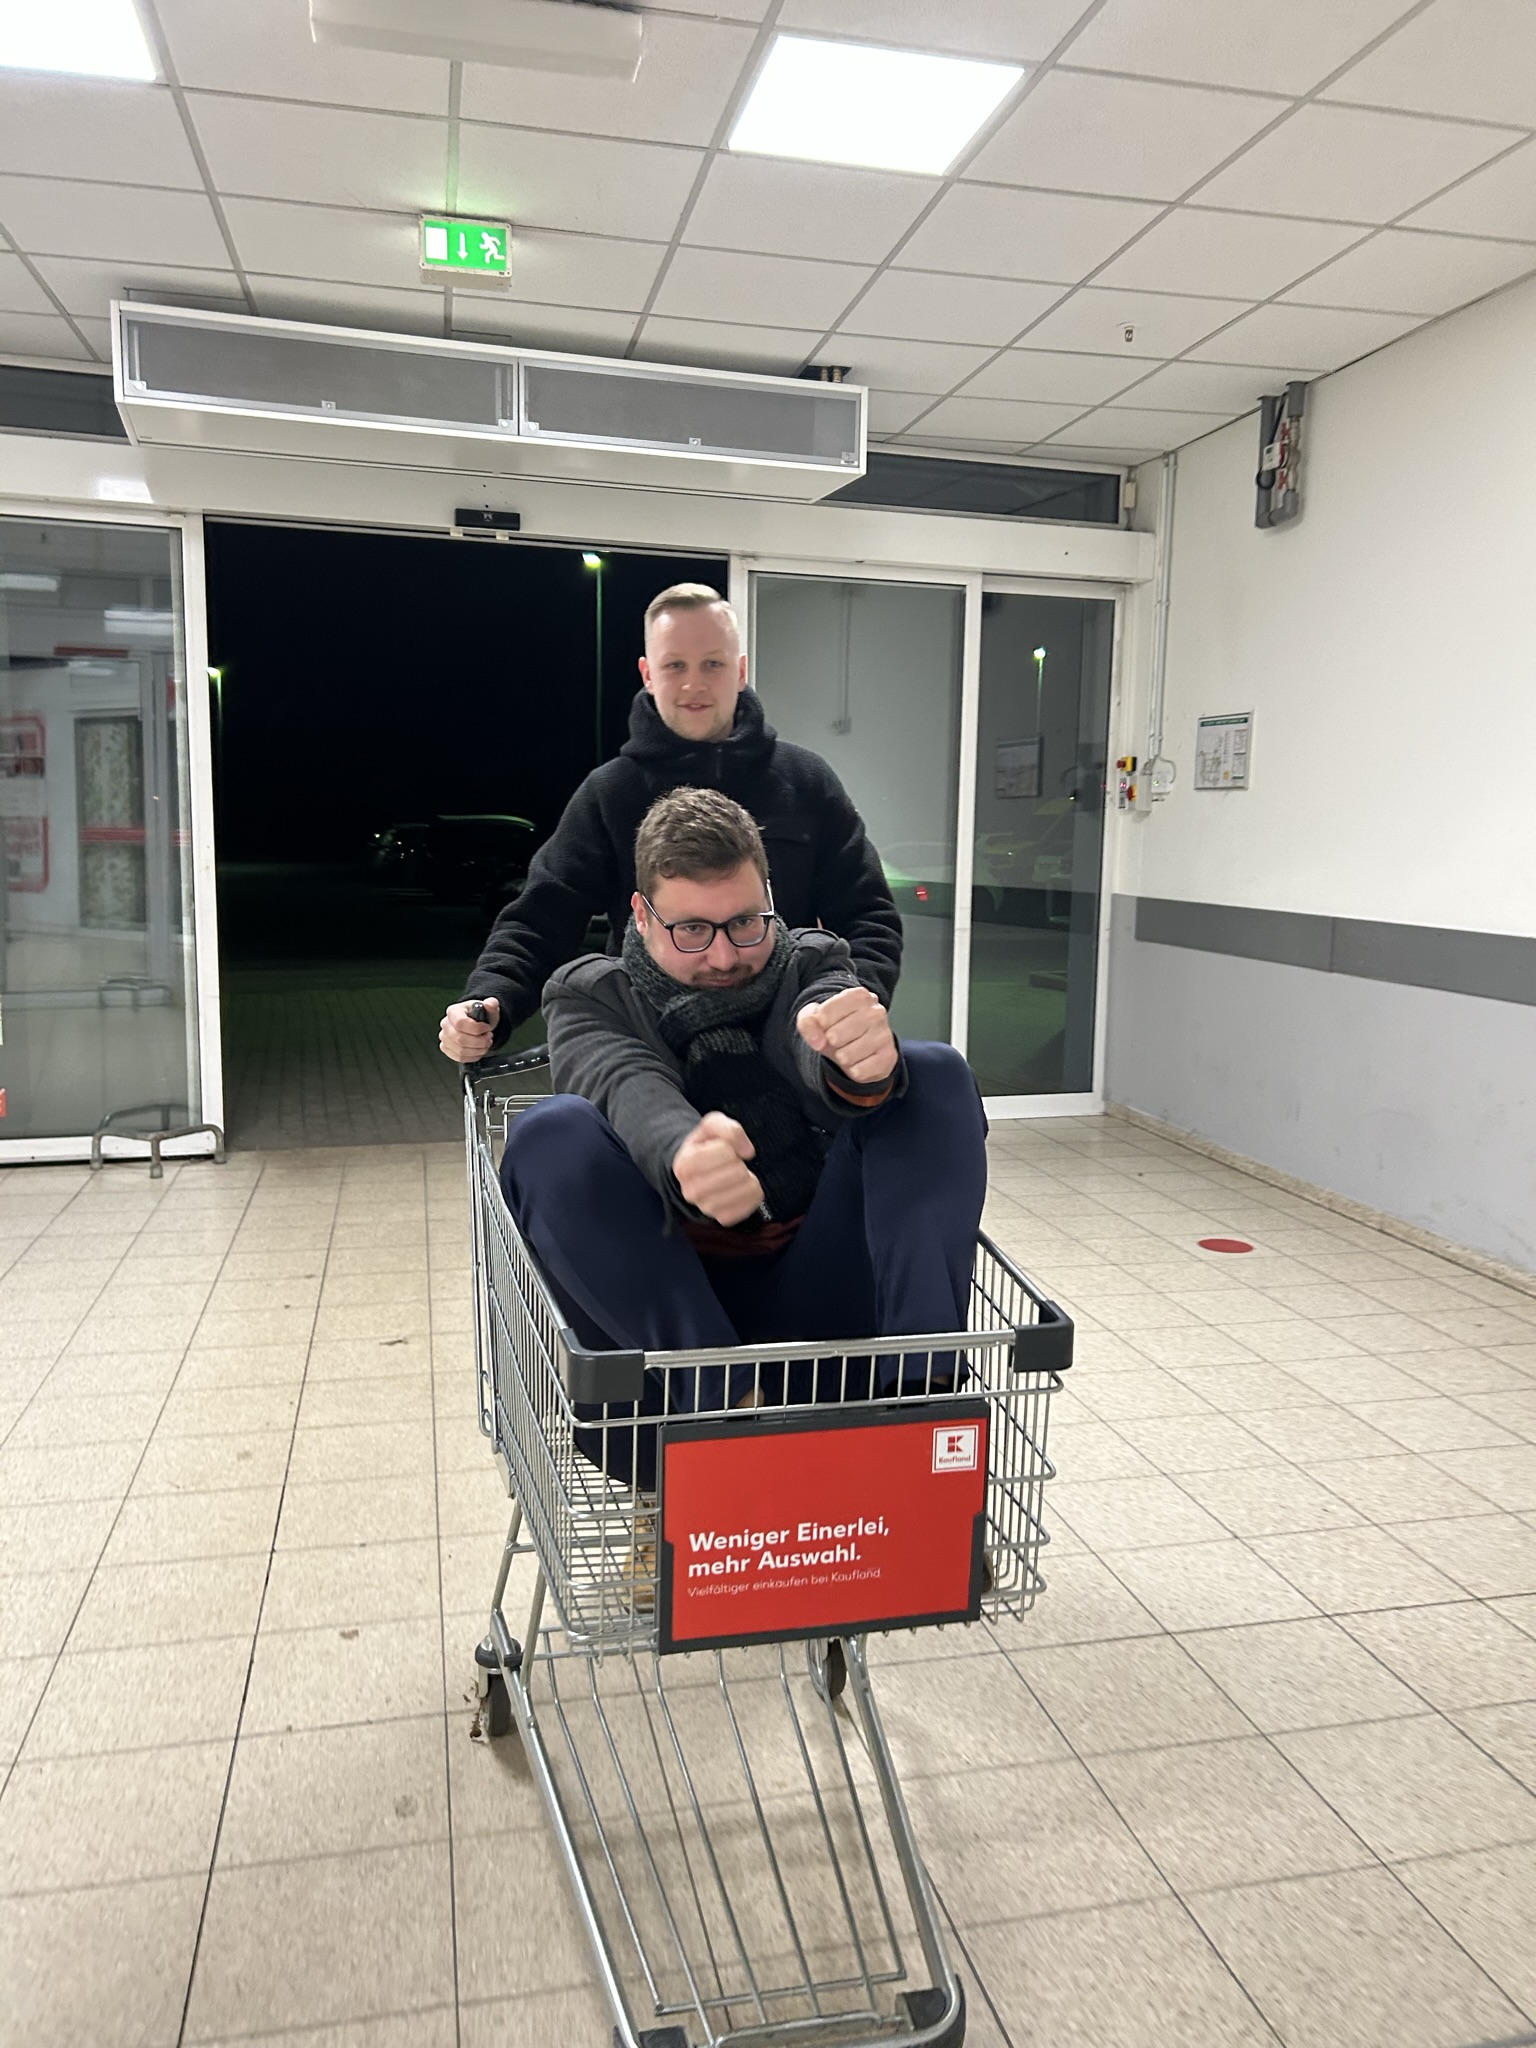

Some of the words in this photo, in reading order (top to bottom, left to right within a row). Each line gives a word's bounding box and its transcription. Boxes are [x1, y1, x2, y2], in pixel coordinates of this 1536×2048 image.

[689, 1529, 790, 1553] Weniger
[797, 1516, 890, 1542] Einerlei,
[688, 1555, 751, 1578] mehr
[757, 1542, 862, 1570] Auswahl.
[752, 1575, 808, 1590] einkaufen
[810, 1571, 829, 1585] bei
[830, 1567, 881, 1583] Kaufland
